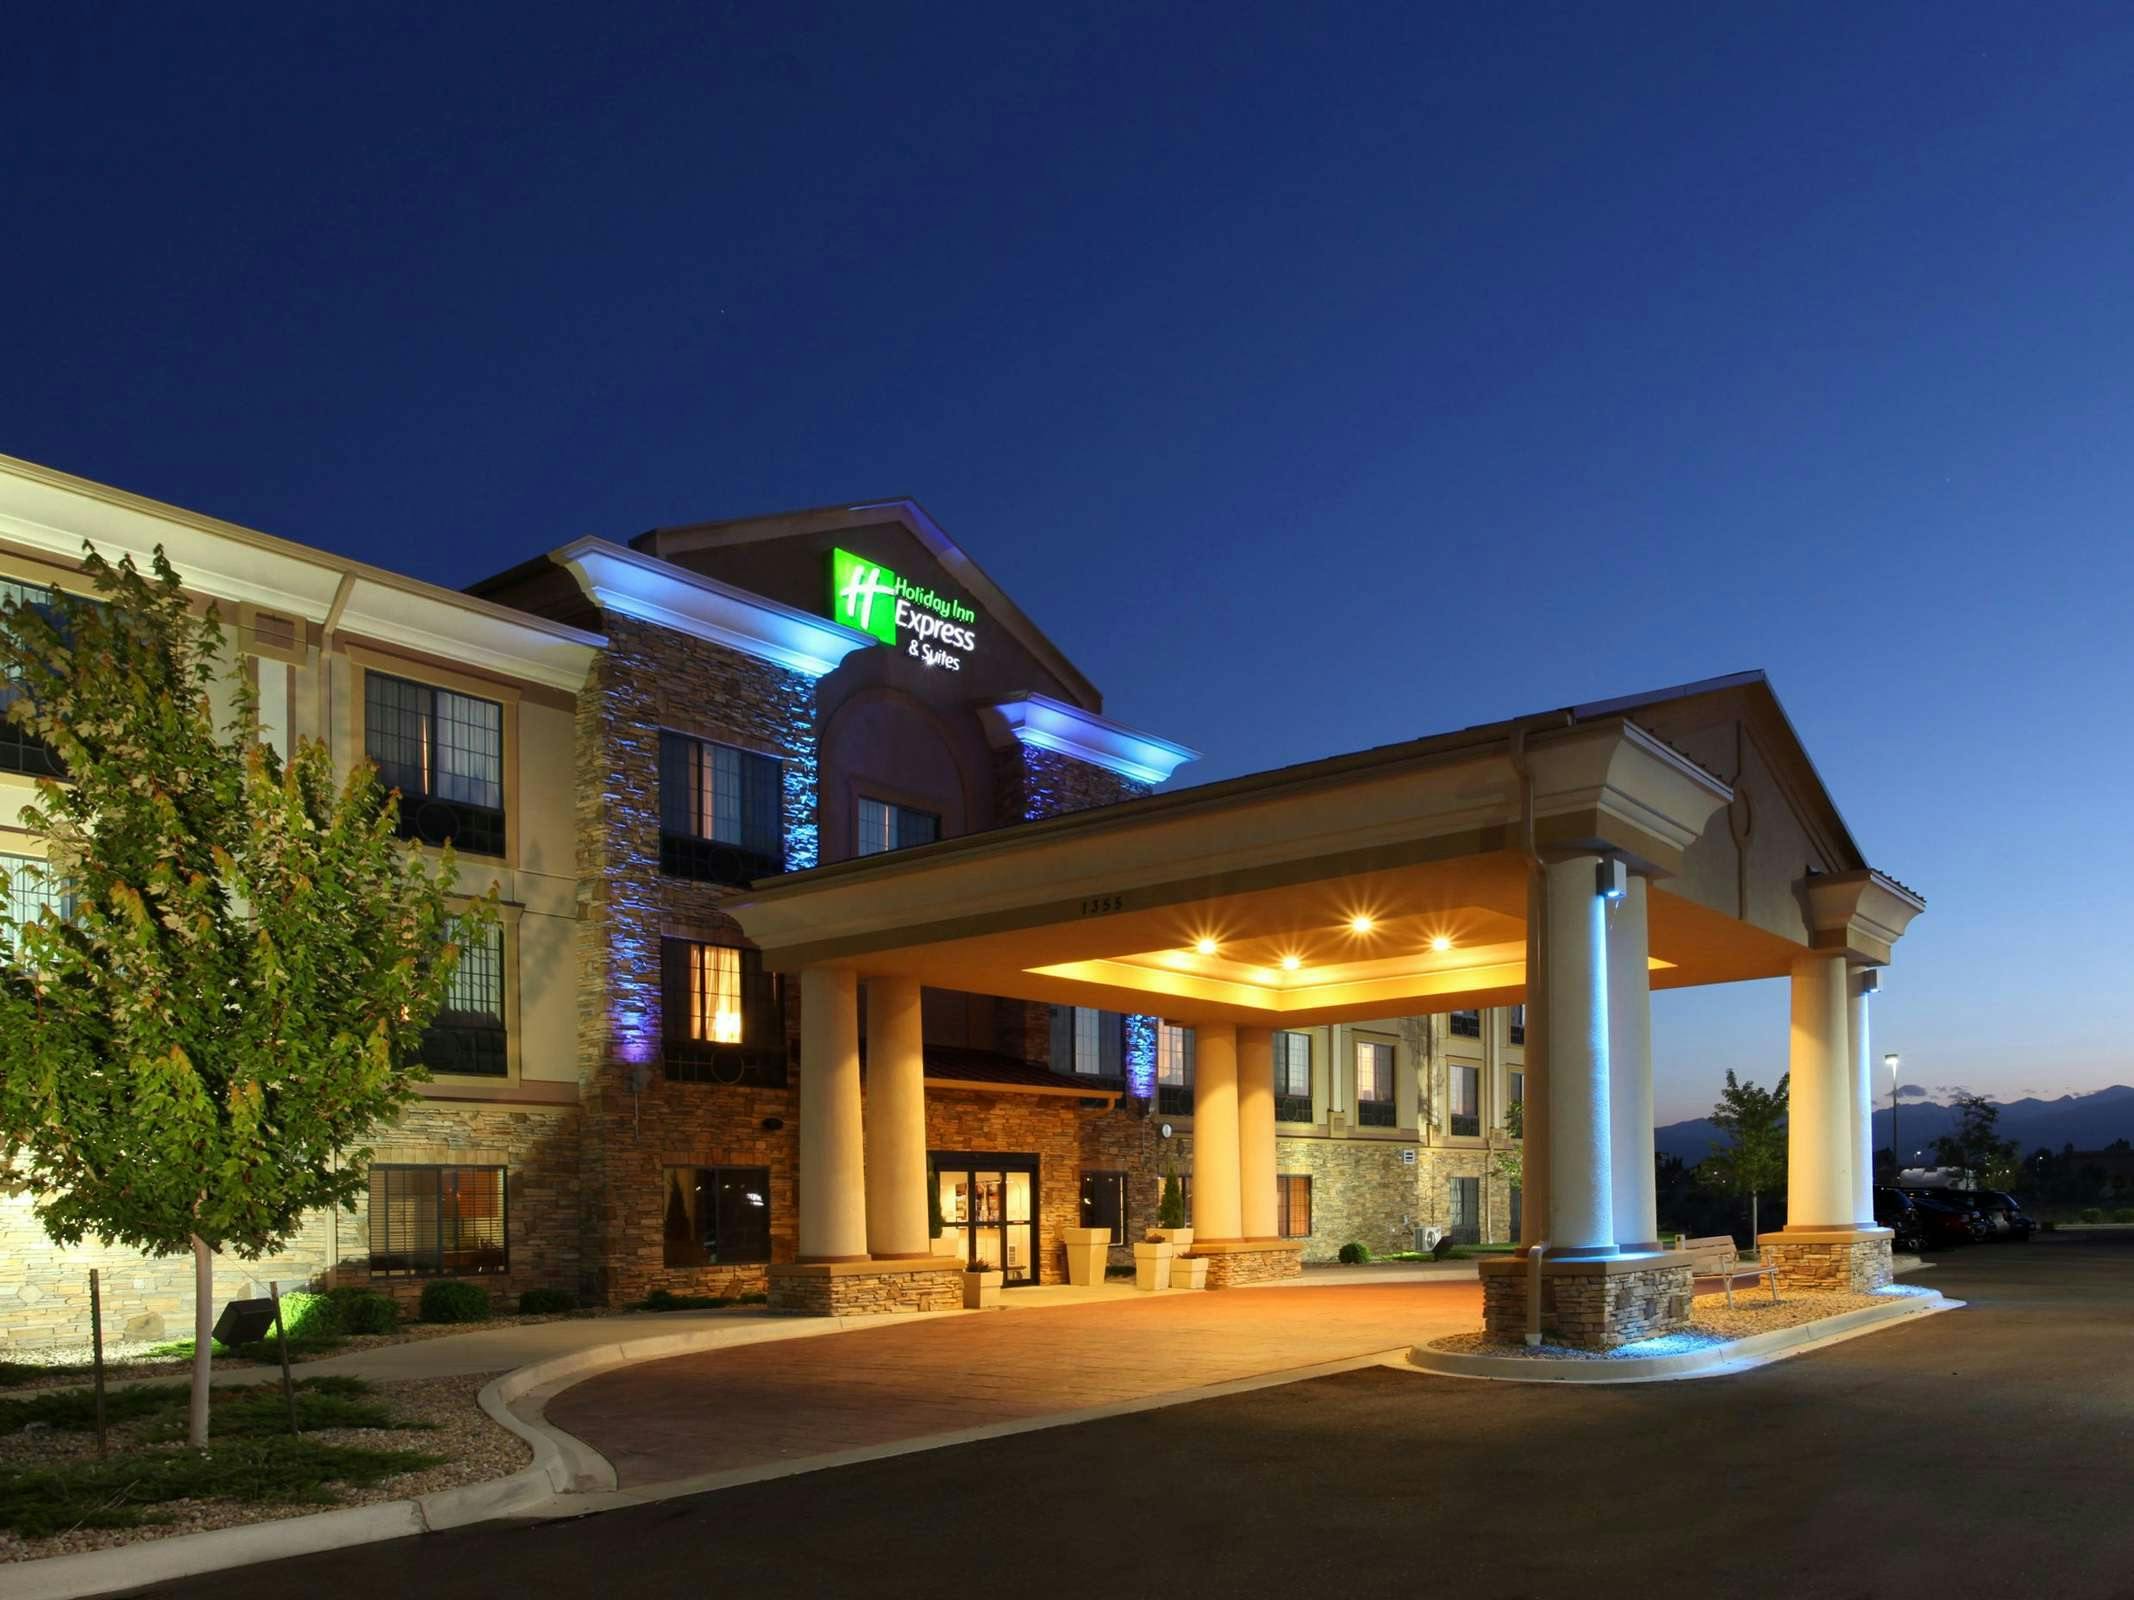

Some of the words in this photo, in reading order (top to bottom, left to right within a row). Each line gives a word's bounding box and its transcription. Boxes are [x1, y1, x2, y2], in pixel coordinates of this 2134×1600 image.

[895, 577, 950, 618] Holiday
[952, 599, 975, 623] Inn
[895, 600, 975, 651] Express
[908, 639, 919, 656] &
[921, 644, 960, 671] Suites
